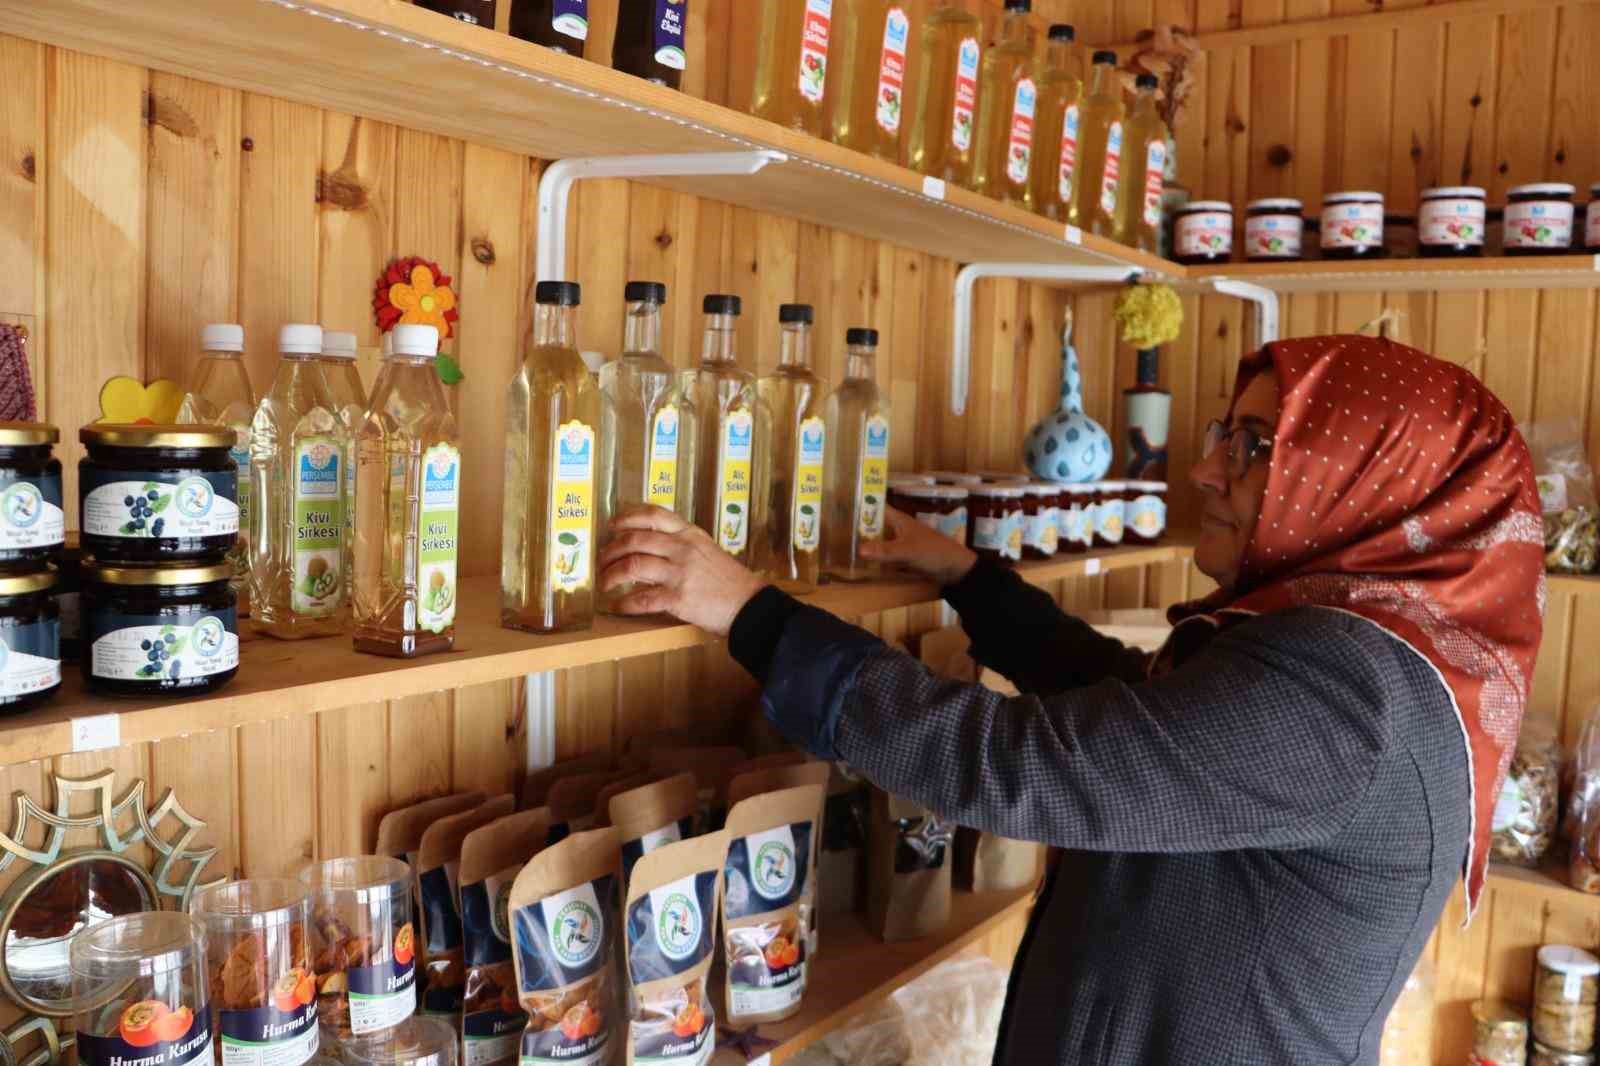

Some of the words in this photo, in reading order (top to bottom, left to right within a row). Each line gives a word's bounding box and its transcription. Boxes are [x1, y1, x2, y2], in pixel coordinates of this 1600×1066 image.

[306, 512, 330, 524] Kivi
[558, 507, 588, 519] Sirkesi
[298, 526, 339, 539] Sirkesi
[428, 523, 448, 536] Kivi
[422, 537, 454, 551] Sirkesi
[263, 1016, 305, 1039] Hurma
[110, 1053, 165, 1066] Hurma
[168, 1029, 209, 1060] Kurusu
